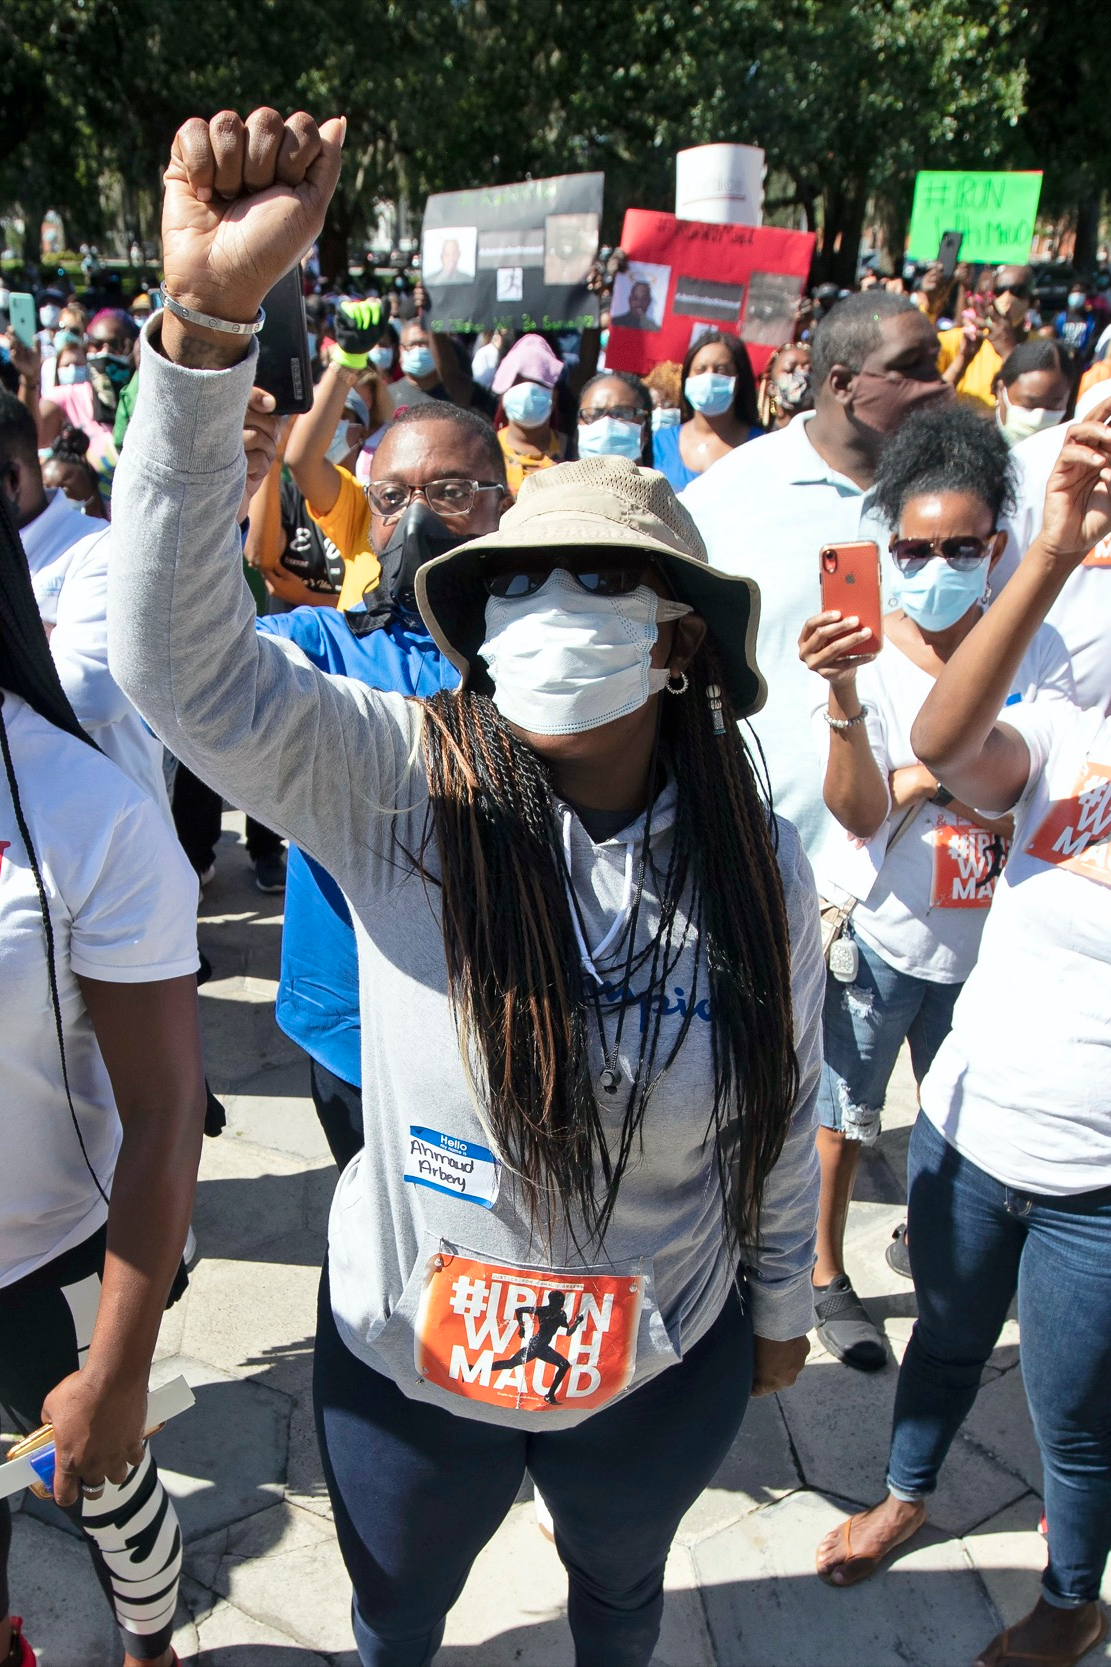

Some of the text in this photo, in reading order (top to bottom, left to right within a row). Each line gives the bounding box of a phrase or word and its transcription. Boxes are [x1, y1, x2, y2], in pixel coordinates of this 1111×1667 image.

[411, 1140, 474, 1174] Ahmaud
[440, 1134, 468, 1151] Hello
[419, 1160, 466, 1192] Arbery
[448, 1344, 602, 1398] MAUD
